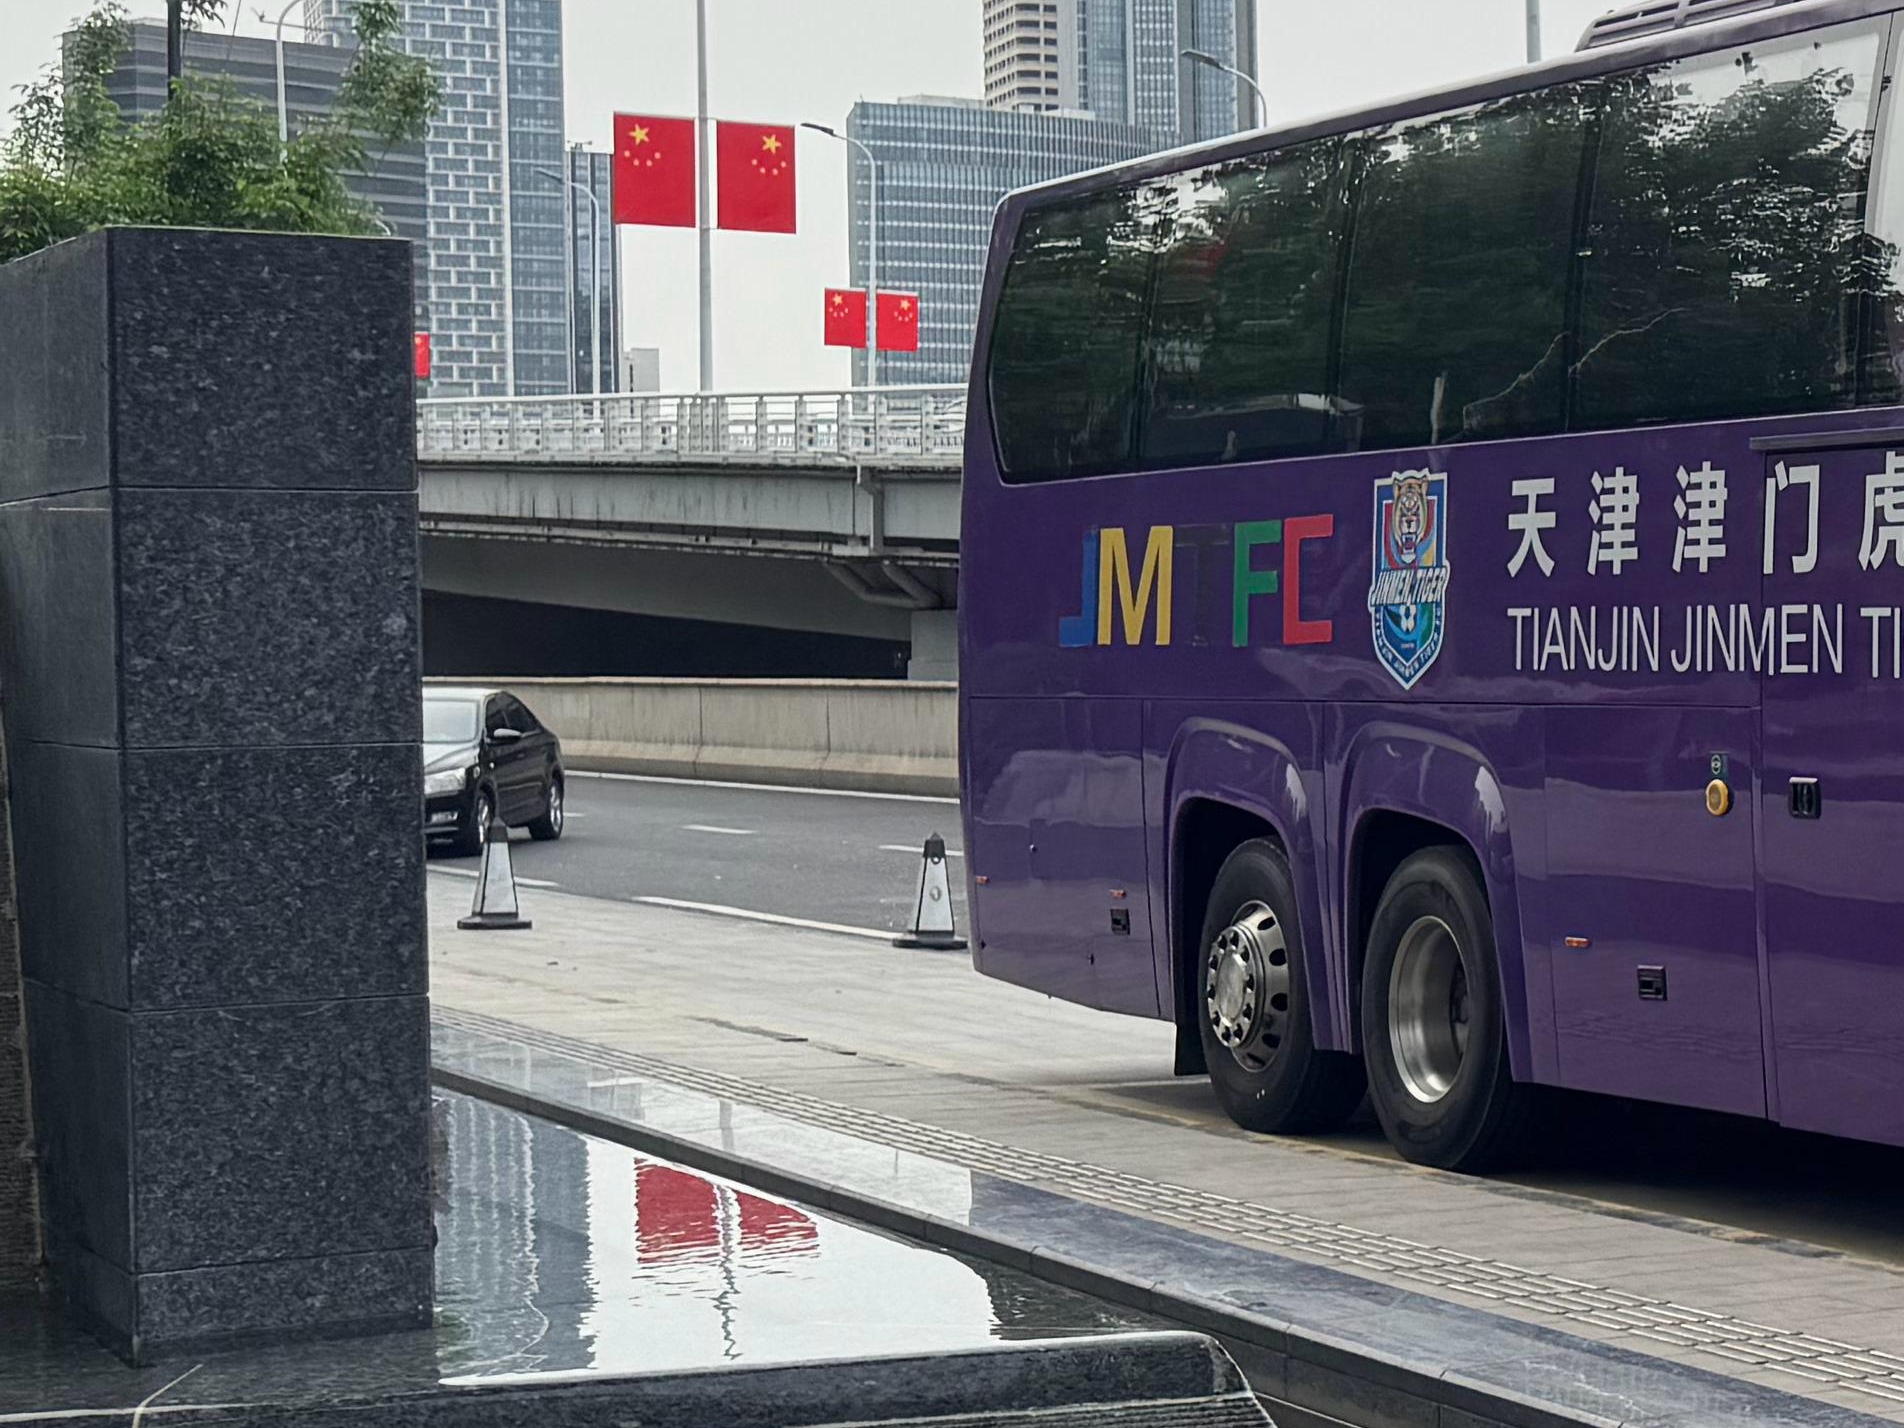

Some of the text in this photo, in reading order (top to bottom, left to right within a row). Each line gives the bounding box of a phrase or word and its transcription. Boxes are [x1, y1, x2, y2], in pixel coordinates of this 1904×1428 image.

[1371, 567, 1447, 605] JINMEN TIGER
[1506, 604, 1660, 672] TIANJIN
[1670, 602, 1844, 676] JINMEN
